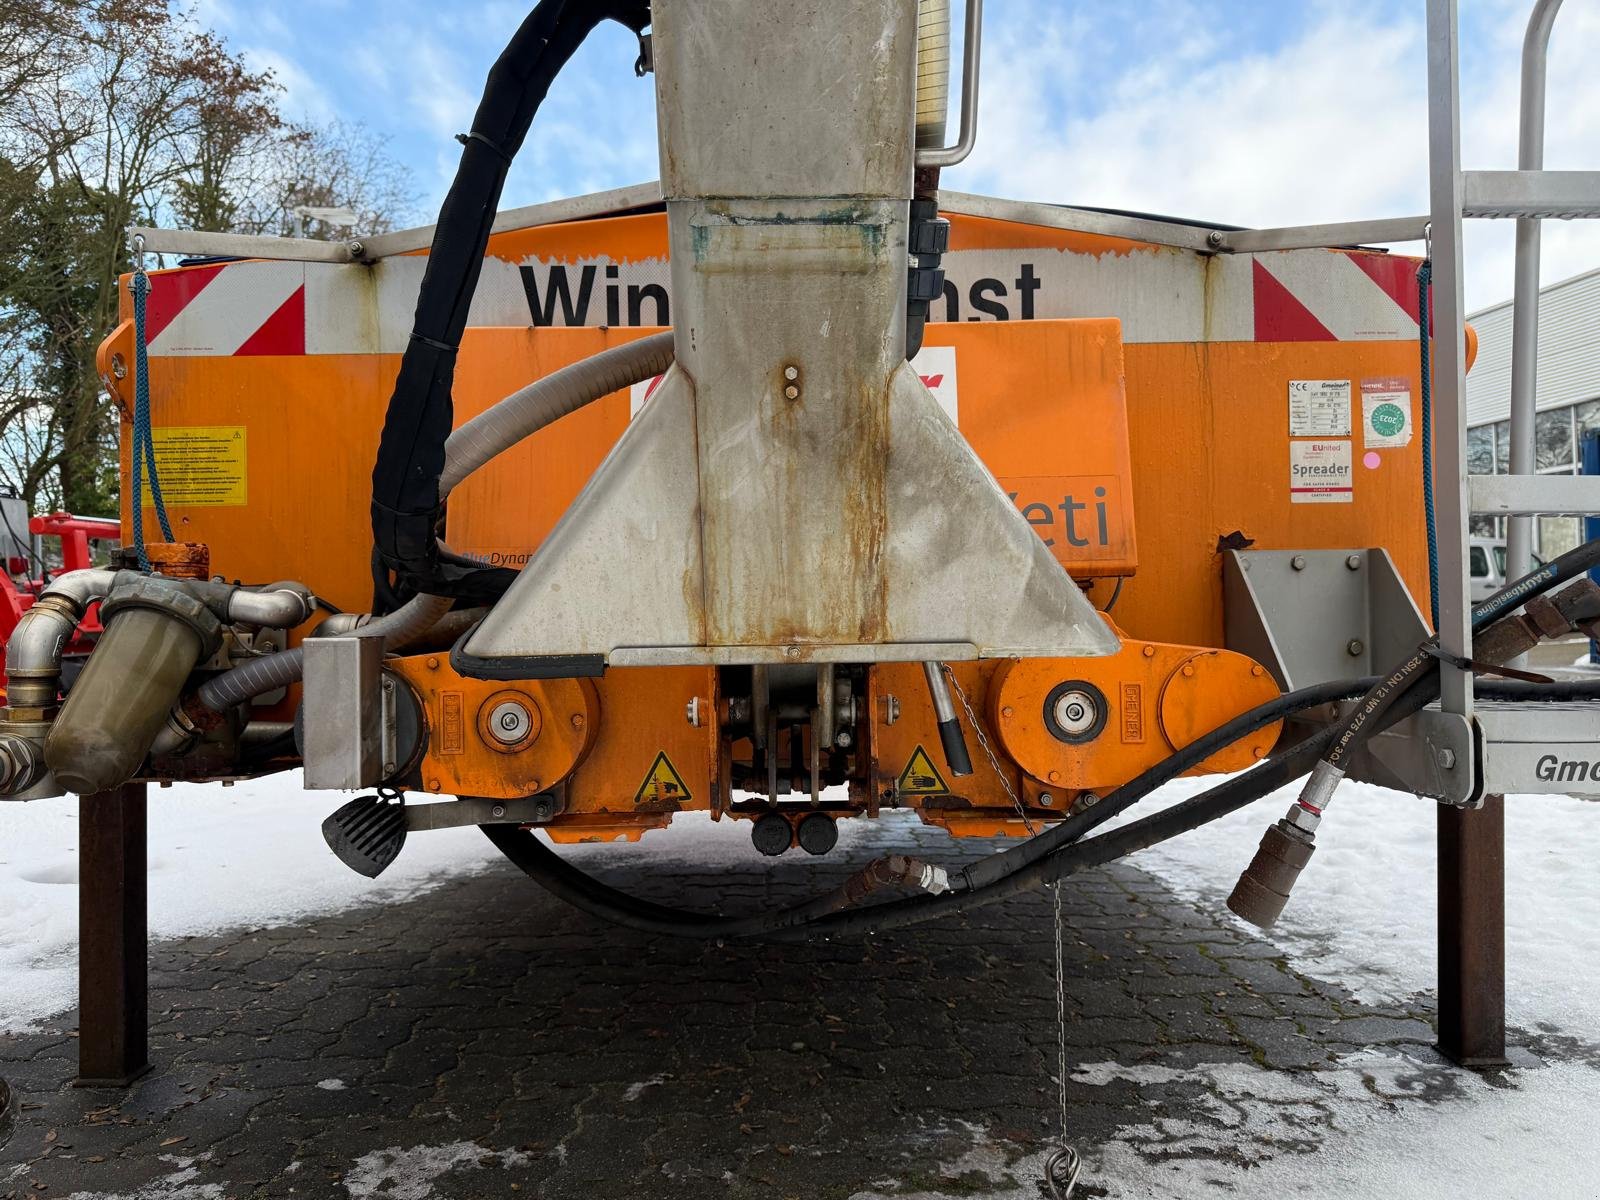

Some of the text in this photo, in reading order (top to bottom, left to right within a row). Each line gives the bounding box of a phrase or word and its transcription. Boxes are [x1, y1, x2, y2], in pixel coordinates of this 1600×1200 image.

[1292, 463, 1350, 478] Spreader
[1008, 486, 1108, 547] eti
[1400, 656, 1421, 676] 2SN
[1387, 672, 1404, 688] DN
[1376, 687, 1390, 698] 12
[1365, 698, 1380, 714] WP
[1350, 712, 1366, 731] 275
[1341, 731, 1355, 745] bar
